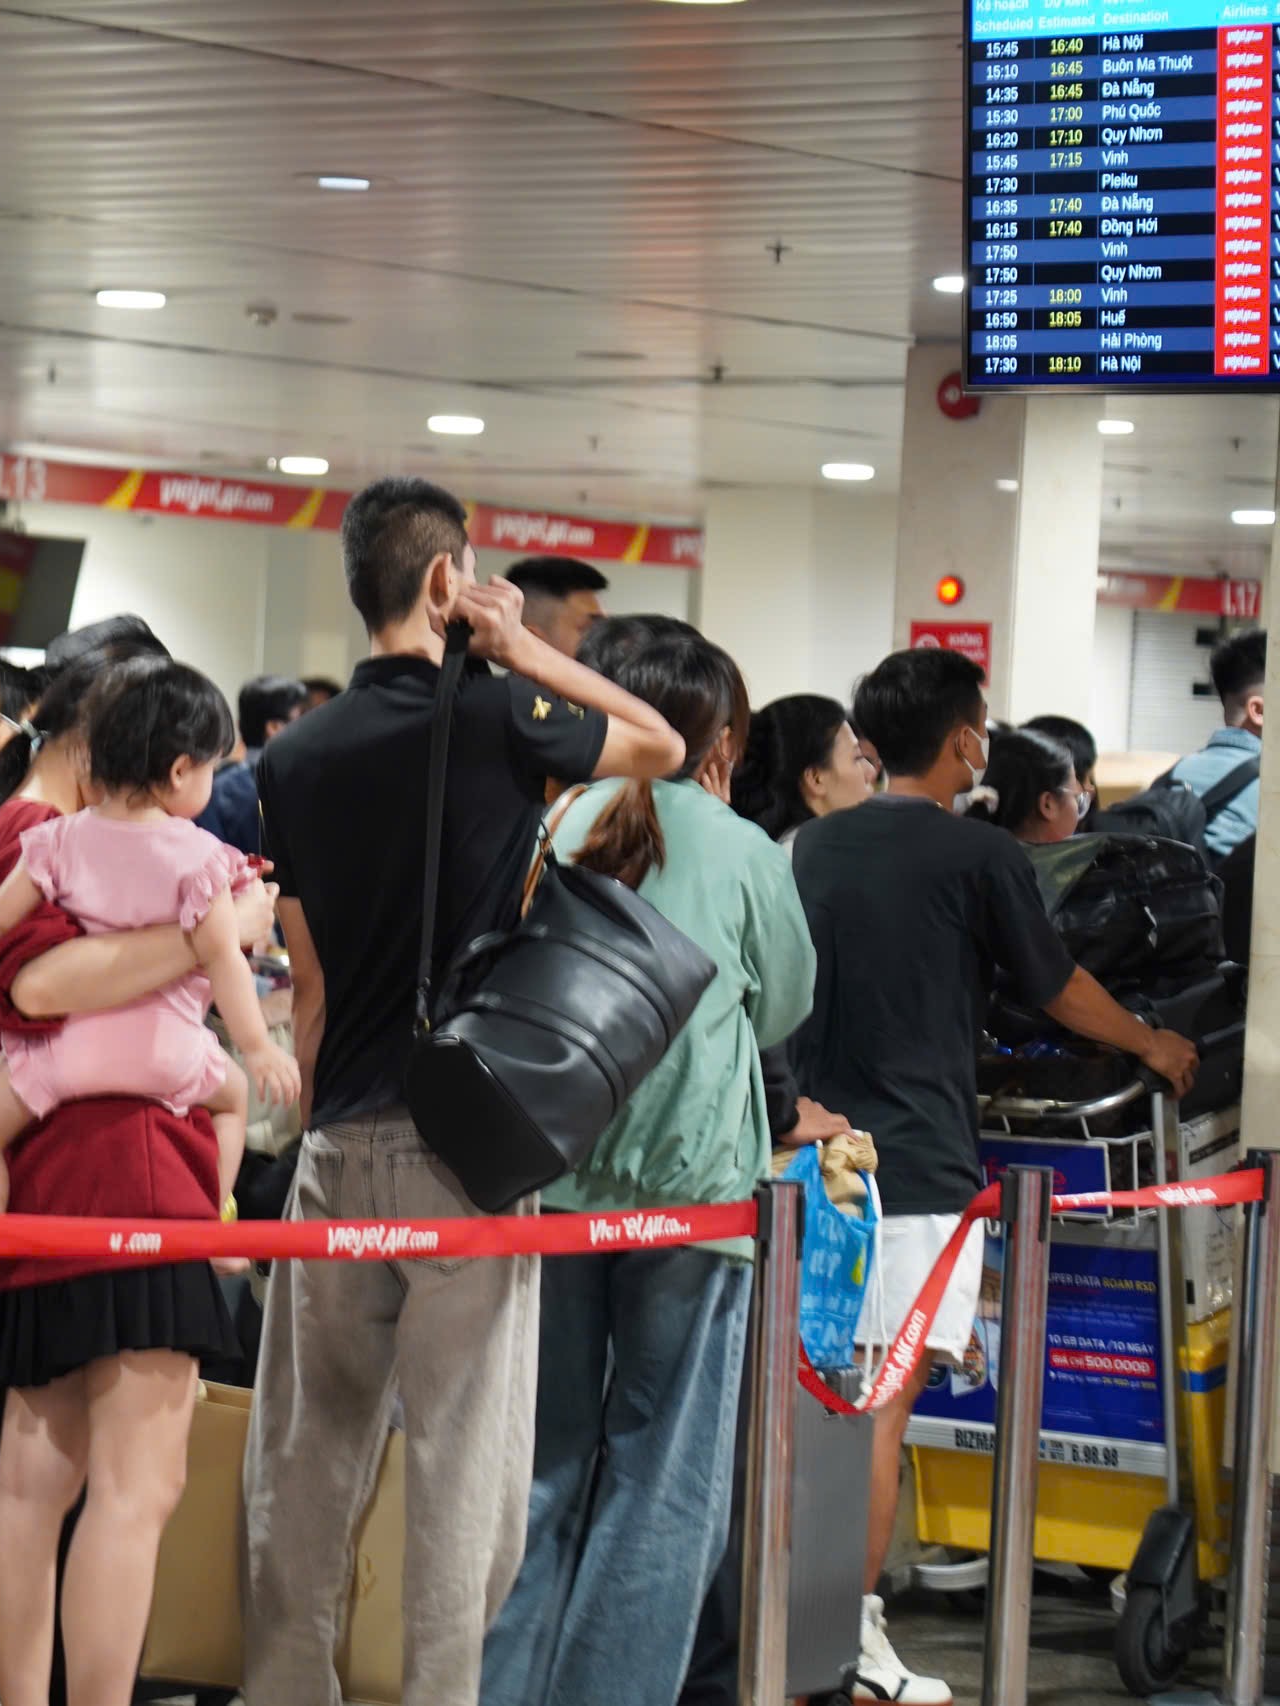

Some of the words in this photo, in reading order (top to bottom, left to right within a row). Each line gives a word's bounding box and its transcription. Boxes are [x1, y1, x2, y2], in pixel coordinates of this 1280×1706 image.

[1223, 5, 1268, 17] Airlines
[976, 16, 1033, 33] Scheduled
[1038, 14, 1095, 29] Estimated
[1103, 10, 1169, 25] Destination
[986, 41, 1019, 57] 15:45
[1051, 38, 1083, 54] 16:40
[1103, 36, 1120, 51] Hà
[1123, 34, 1143, 51] Nội
[986, 64, 1018, 81] 15:10
[1050, 61, 1083, 77] 16:45
[1102, 58, 1133, 75] Buôn
[1136, 57, 1156, 72] Ma
[987, 87, 1018, 103] 14:35
[1051, 84, 1082, 99] 16:45
[1102, 82, 1120, 97] Đà
[986, 109, 1018, 126] 15:30
[1050, 106, 1083, 123] 17:00
[1102, 104, 1126, 120] Phú
[1128, 102, 1161, 122] Quốc
[987, 132, 1018, 148] 16:20
[1051, 129, 1082, 145] 17:10
[1102, 128, 1127, 144] Quy
[986, 154, 1018, 171] 15:45
[1050, 152, 1082, 168] 17:15
[1102, 150, 1128, 166] Vinh
[986, 177, 1017, 193] 17:30
[1102, 173, 1137, 188] Pleiku
[986, 199, 1018, 216] 16:35
[1049, 198, 1082, 214] 17:40
[1101, 196, 1119, 212] Đà
[986, 222, 1017, 238] 16:15
[1050, 221, 1082, 236] 17:40
[986, 245, 1017, 261] 17:50
[1101, 241, 1128, 258] Vinh
[986, 268, 1017, 283] 17:50
[1101, 265, 1126, 282] Quy
[986, 289, 1017, 306] 17:25
[1049, 289, 1082, 304] 18:00
[1101, 287, 1127, 303] Vinh
[986, 313, 1017, 328] 16:50
[1050, 311, 1081, 326] 18:05
[985, 335, 1017, 351] 18:05
[1124, 332, 1162, 350] Phòng
[986, 357, 1017, 373] 17:30
[1050, 357, 1081, 372] 18:10
[1101, 356, 1118, 371] Hà
[1121, 356, 1140, 372] Nội
[1047, 1272, 1073, 1284] UPER
[1075, 1274, 1102, 1288] DATA
[1048, 1333, 1061, 1344] 10
[1079, 1337, 1106, 1350] DATA
